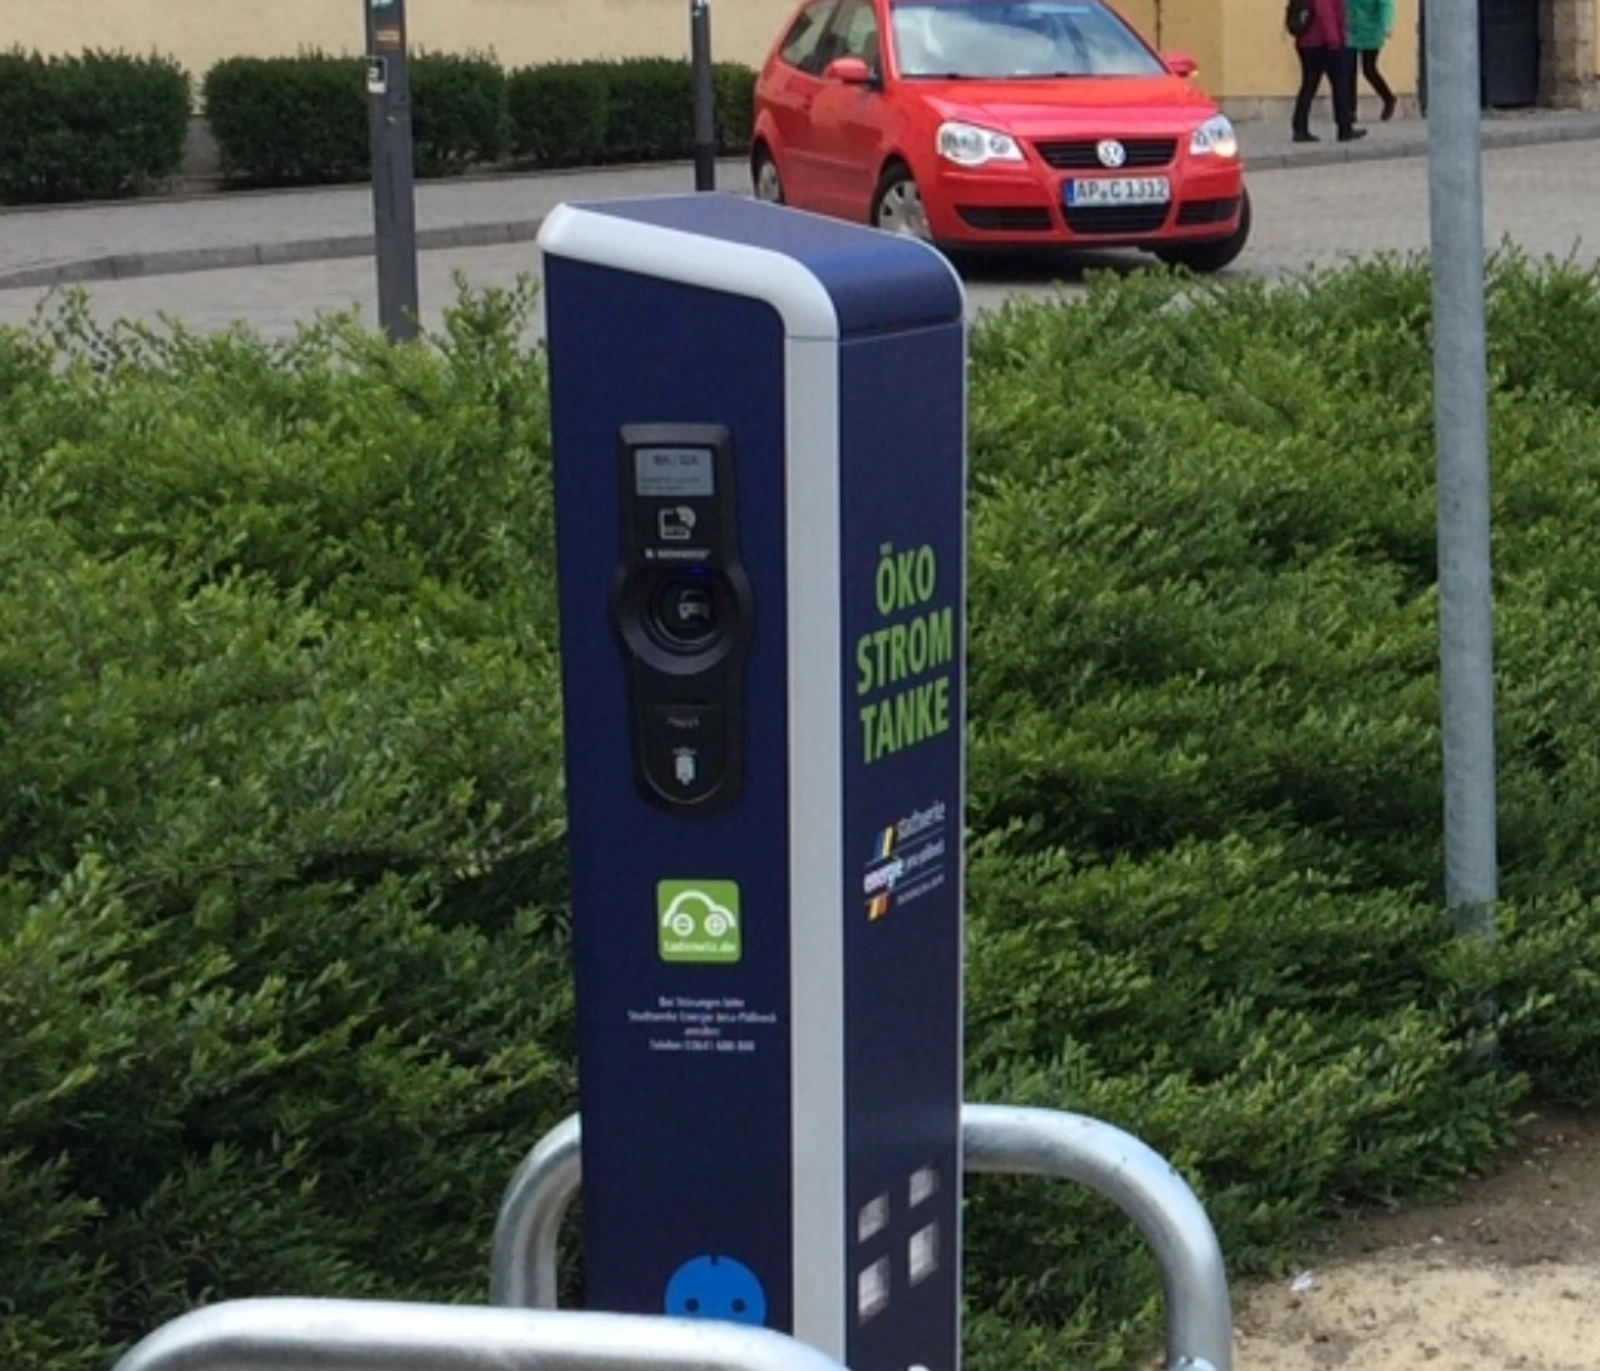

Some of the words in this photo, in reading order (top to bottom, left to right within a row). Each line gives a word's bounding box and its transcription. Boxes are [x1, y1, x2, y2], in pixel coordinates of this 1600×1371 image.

[1077, 181, 1099, 199] AP
[1110, 180, 1120, 198] C
[876, 541, 936, 616] ÖKO
[857, 605, 953, 695] STROM
[860, 676, 950, 765] TANKE
